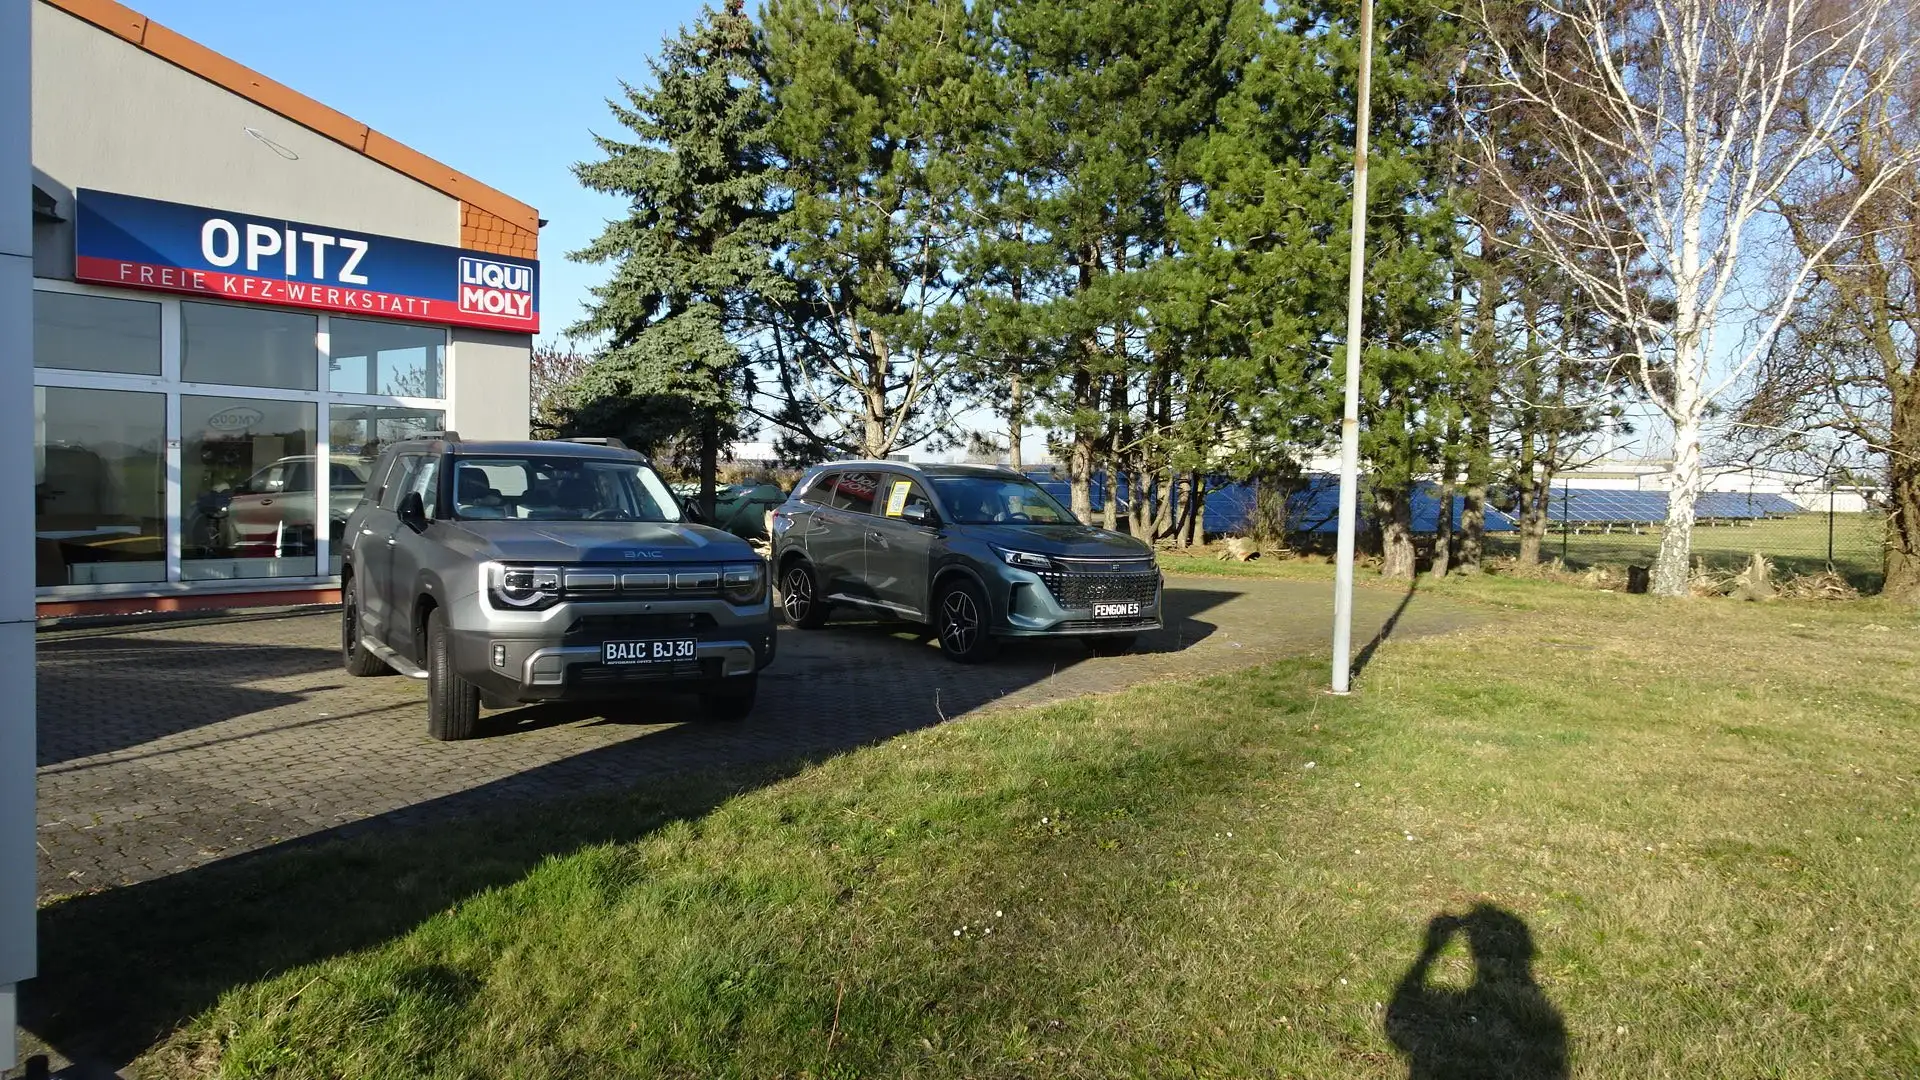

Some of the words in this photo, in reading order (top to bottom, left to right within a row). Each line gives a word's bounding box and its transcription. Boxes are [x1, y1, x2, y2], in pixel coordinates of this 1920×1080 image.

[202, 218, 368, 285] OPITZ
[120, 263, 205, 289] FREIE
[224, 276, 430, 315] KFZ-WERKSTATT
[463, 261, 528, 291] LIQUI
[463, 287, 530, 316] MOLY
[1095, 604, 1127, 616] FENGON
[1128, 603, 1139, 614] E5
[606, 643, 646, 659] BAIC
[653, 641, 693, 658] BJ30
